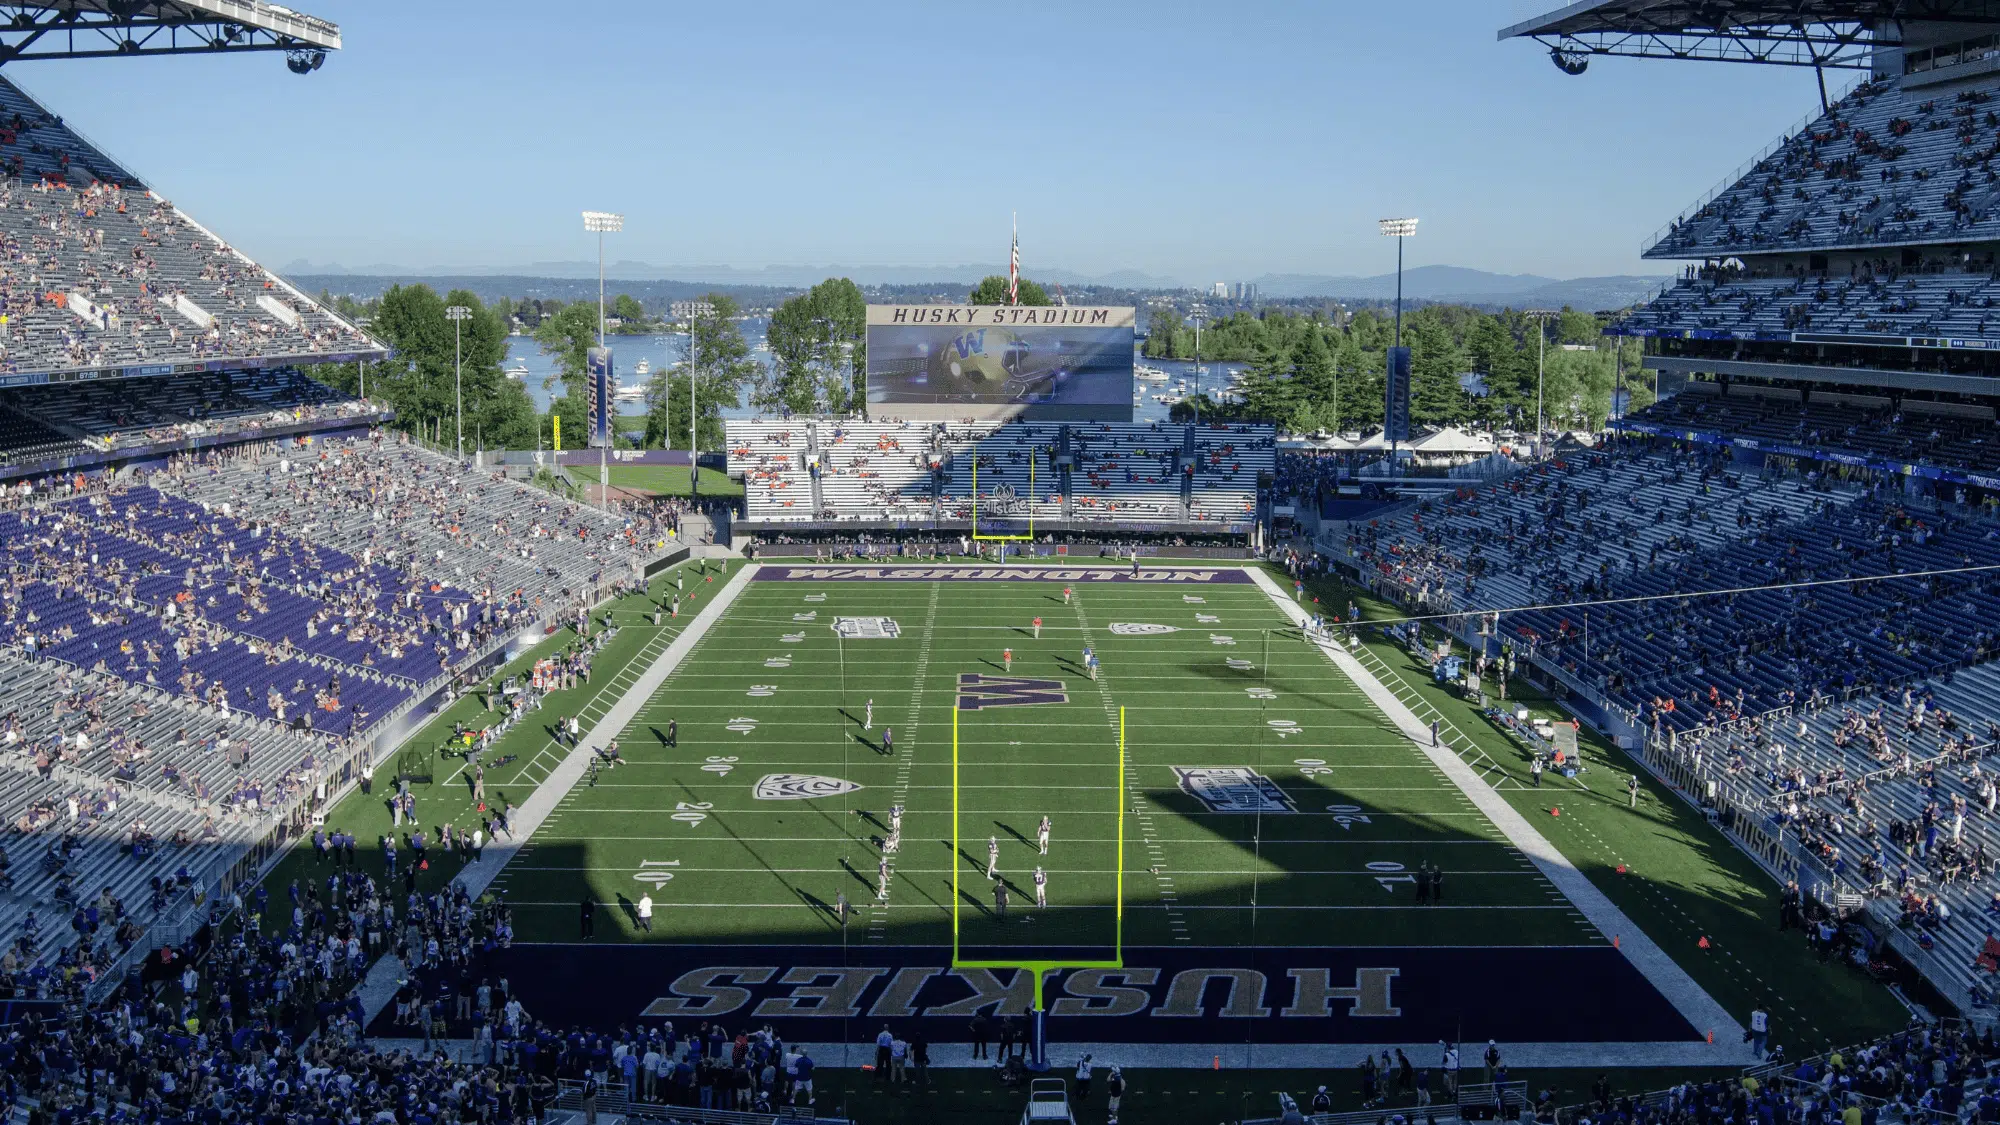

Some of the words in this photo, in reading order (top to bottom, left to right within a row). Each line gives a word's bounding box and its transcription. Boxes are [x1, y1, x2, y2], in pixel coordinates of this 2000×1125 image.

[893, 308, 979, 323] HUSKY
[992, 309, 1109, 324] STADIUM
[953, 328, 988, 360] W
[588, 365, 598, 443] HUSKIES
[982, 499, 1028, 514] Allstate
[786, 569, 1218, 581] WASHINGTON
[955, 673, 1070, 710] W
[725, 717, 759, 731] 40
[1267, 720, 1303, 735] 40
[700, 756, 739, 773] 30
[1294, 758, 1334, 775] 30
[670, 802, 713, 822] 20
[1326, 804, 1372, 824] 20
[1642, 741, 1728, 815] WASHINGTN
[1733, 811, 1801, 884] HUSKIES
[633, 860, 680, 882] 10
[1365, 861, 1417, 885] 10
[638, 965, 1403, 1018] HUSKIES
